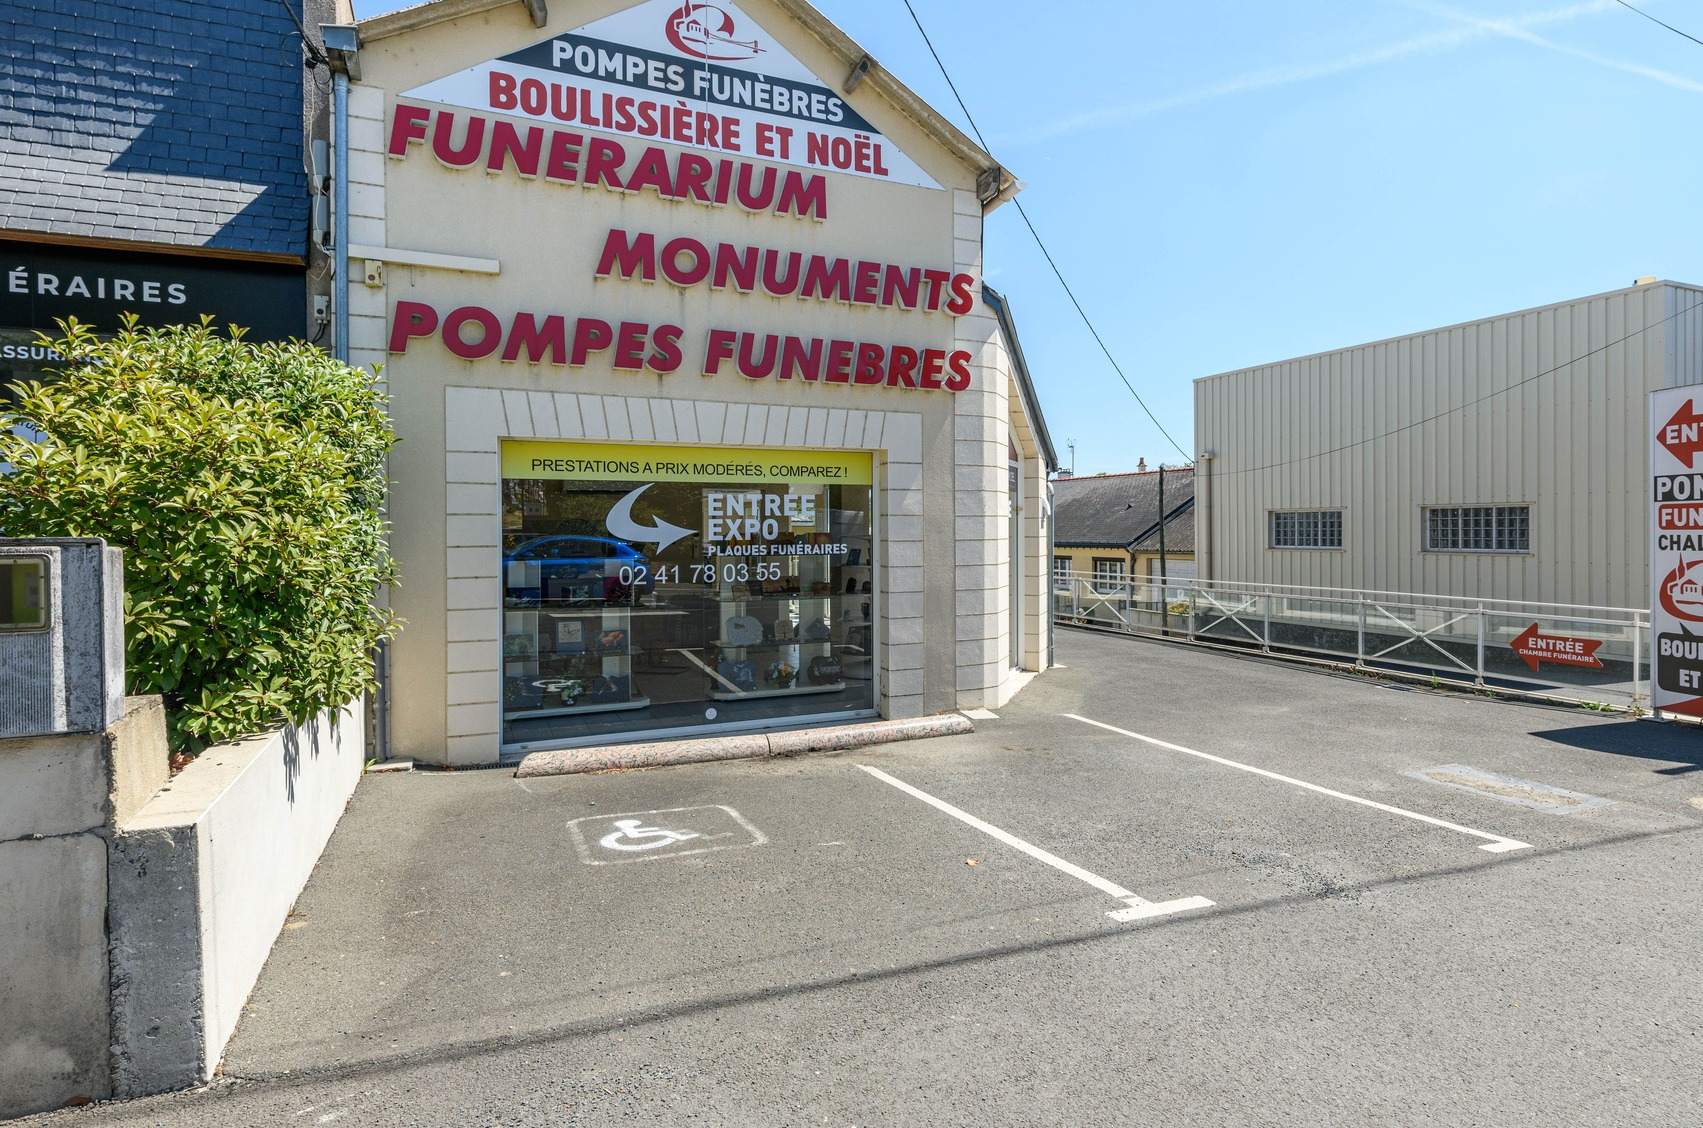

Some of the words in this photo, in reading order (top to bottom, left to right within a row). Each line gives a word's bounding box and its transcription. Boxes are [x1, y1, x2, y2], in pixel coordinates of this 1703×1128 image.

[551, 39, 685, 92] POMPES
[693, 68, 844, 123] FUNÈBRES
[488, 70, 742, 153] BOULISSIÈRE
[755, 121, 793, 160] ET
[806, 132, 889, 177] NOËL
[388, 103, 828, 223] FUNERARIUM
[594, 228, 975, 317] MONUMENTS
[388, 300, 683, 374] POMPES
[702, 328, 974, 393] FUNEBRES
[1665, 422, 1703, 445] EN
[531, 458, 639, 474] PRESTATIONS
[641, 461, 653, 474] A
[655, 462, 689, 475] PRIX
[693, 460, 767, 478] MODÉRÉS,
[769, 464, 842, 478] COMPAREZ
[708, 518, 779, 541] EXPO
[708, 544, 767, 556] PLAQUES
[771, 541, 848, 556] FUNÉRAIRES
[618, 565, 648, 586] 02
[654, 564, 680, 585] 41
[690, 563, 716, 584] 78
[723, 563, 749, 583] 03
[756, 562, 781, 582] 55
[1519, 648, 1552, 658] CHAMBRE
[1553, 652, 1595, 663] FUNÉRAIRE
[1528, 637, 1584, 654] ENTRÉE
[1679, 669, 1701, 689] ET
